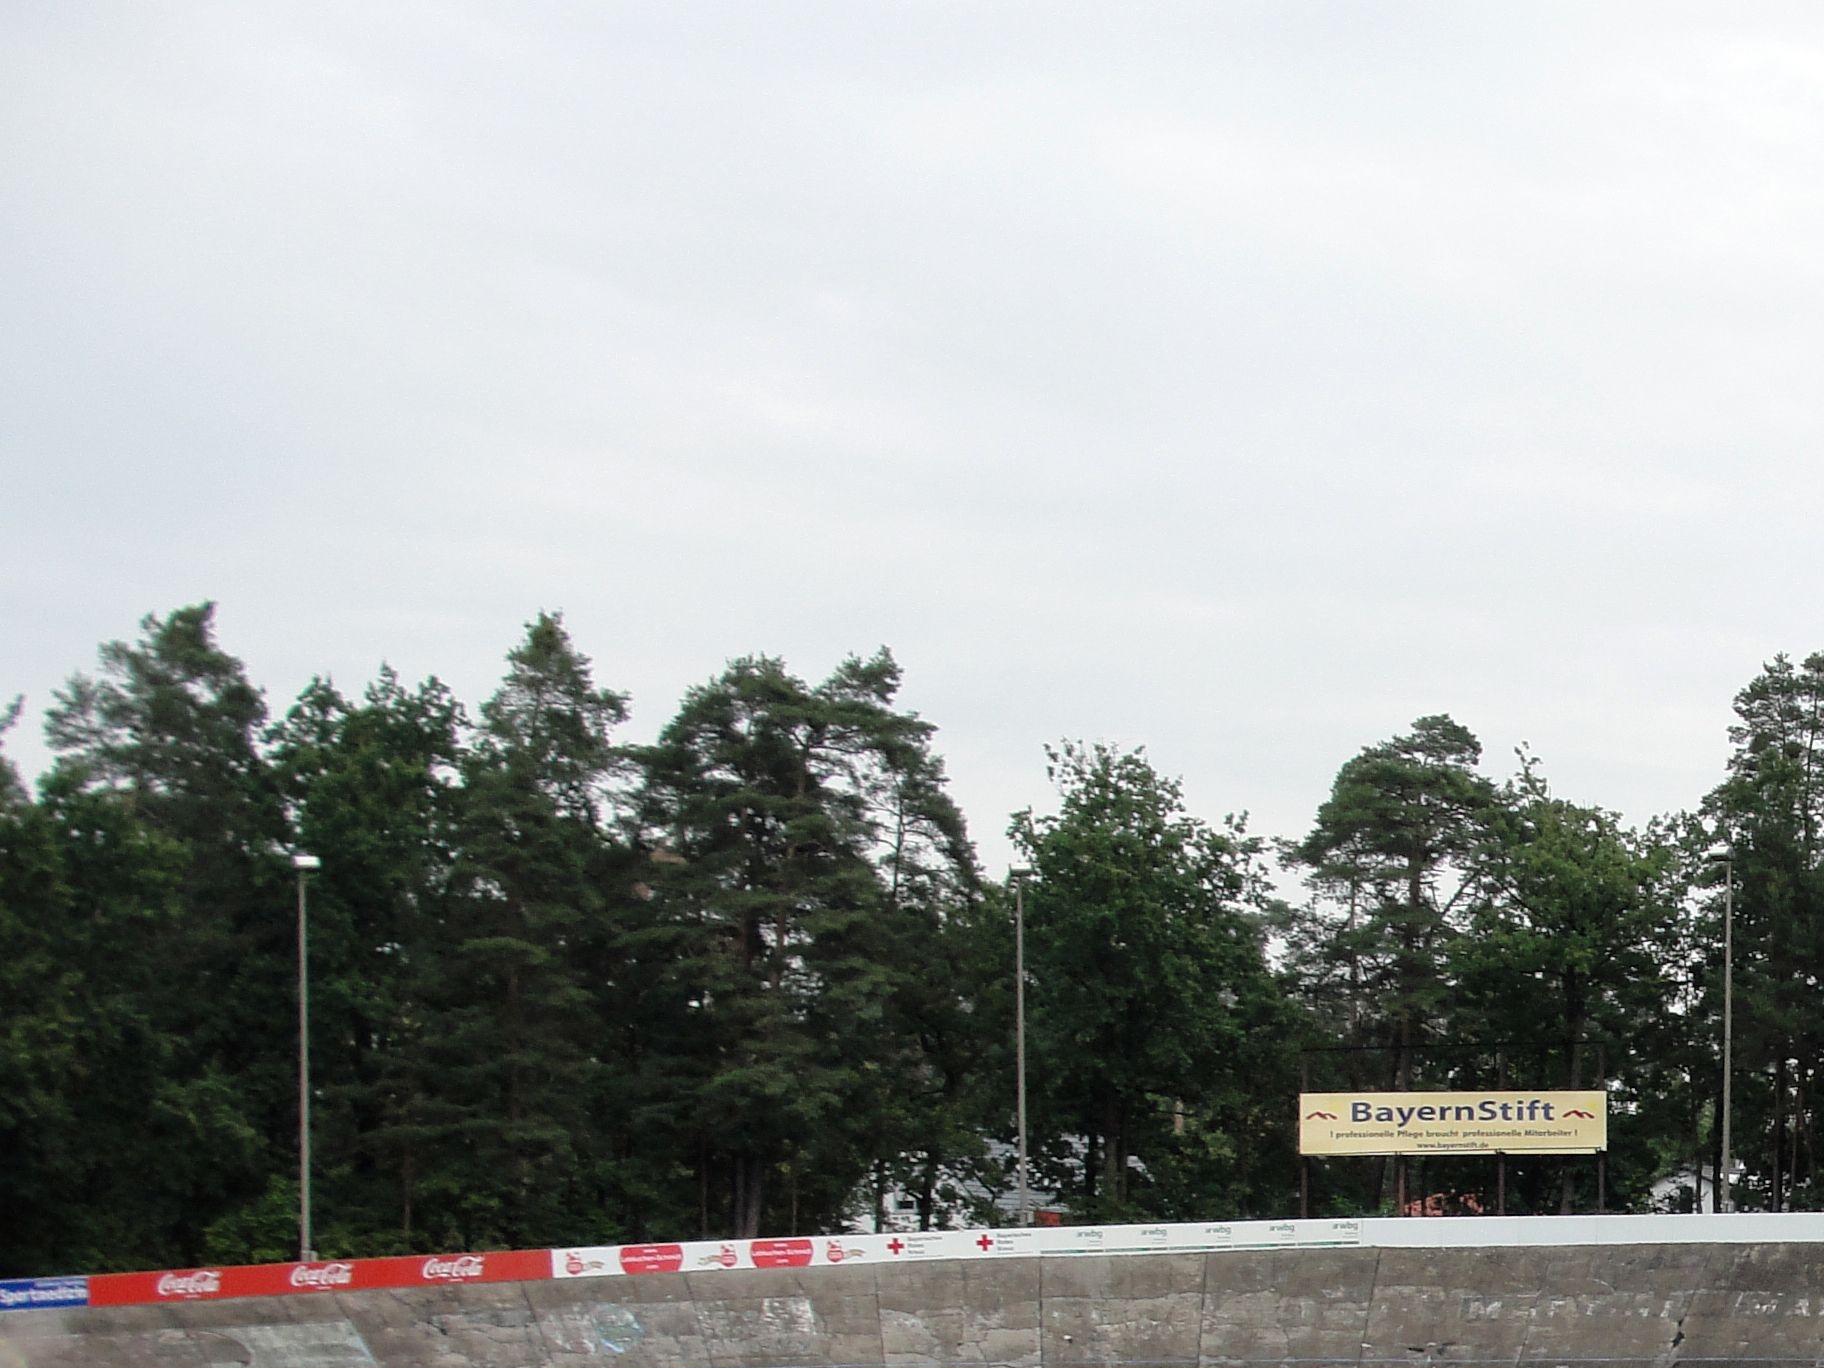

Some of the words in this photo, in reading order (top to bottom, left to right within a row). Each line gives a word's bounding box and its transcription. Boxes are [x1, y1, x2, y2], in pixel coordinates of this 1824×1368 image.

[1351, 1100, 1555, 1127] BayernStift
[1335, 1130, 1394, 1139] professionelle
[1397, 1129, 1424, 1139] Pflege
[1426, 1129, 1459, 1138] braucht
[1462, 1129, 1522, 1138] professionelle
[1524, 1129, 1572, 1137] Mitarbeiter
[1416, 1141, 1489, 1150] www.bayernstift.de
[290, 1263, 353, 1287] Coca-Cola
[422, 1255, 485, 1280] Coca-Cola
[157, 1271, 222, 1296] Coca-Cola
